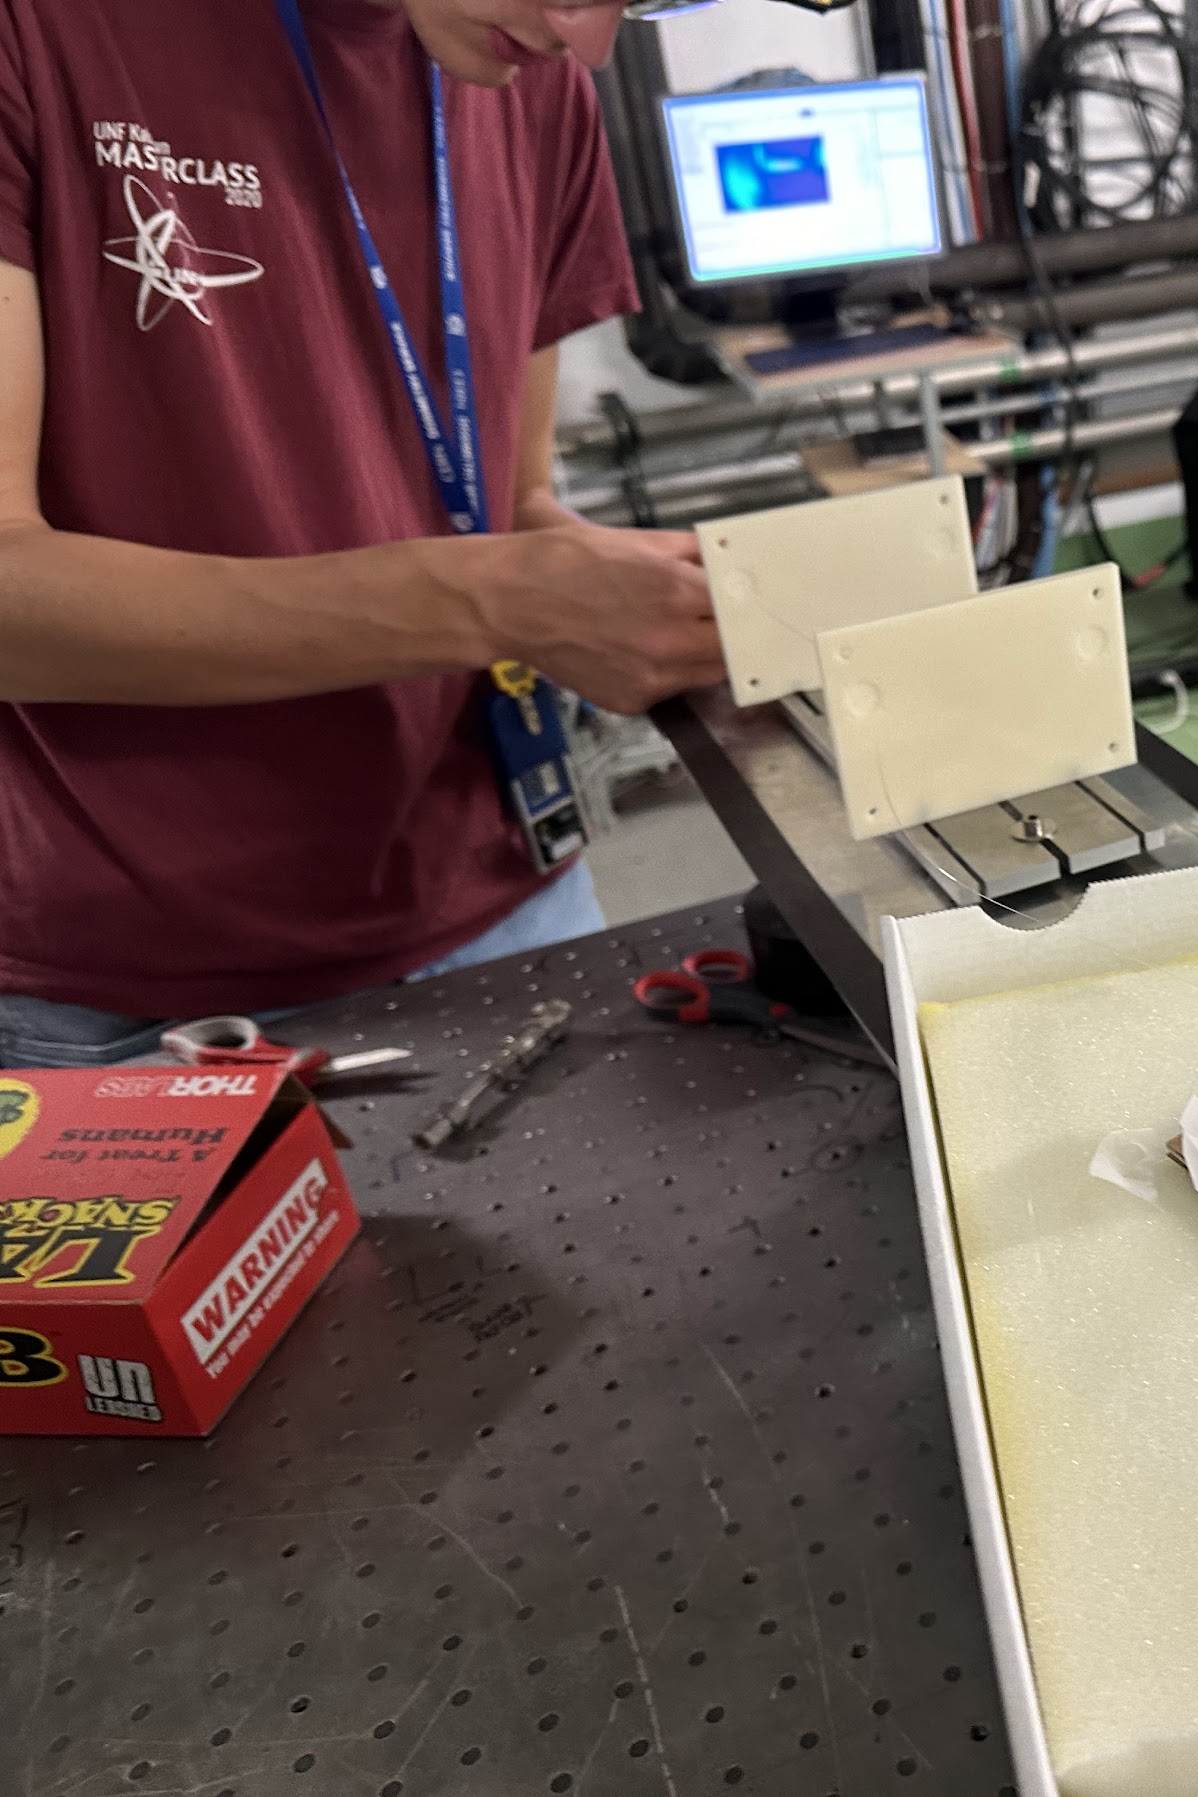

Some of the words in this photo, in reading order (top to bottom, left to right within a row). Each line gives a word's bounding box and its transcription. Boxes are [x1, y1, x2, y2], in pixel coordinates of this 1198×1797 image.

[95, 141, 261, 190] MASRCLASS
[57, 1127, 228, 1146] Humans
[0, 1194, 181, 1228] SNACK
[191, 1177, 326, 1343] WARNING
